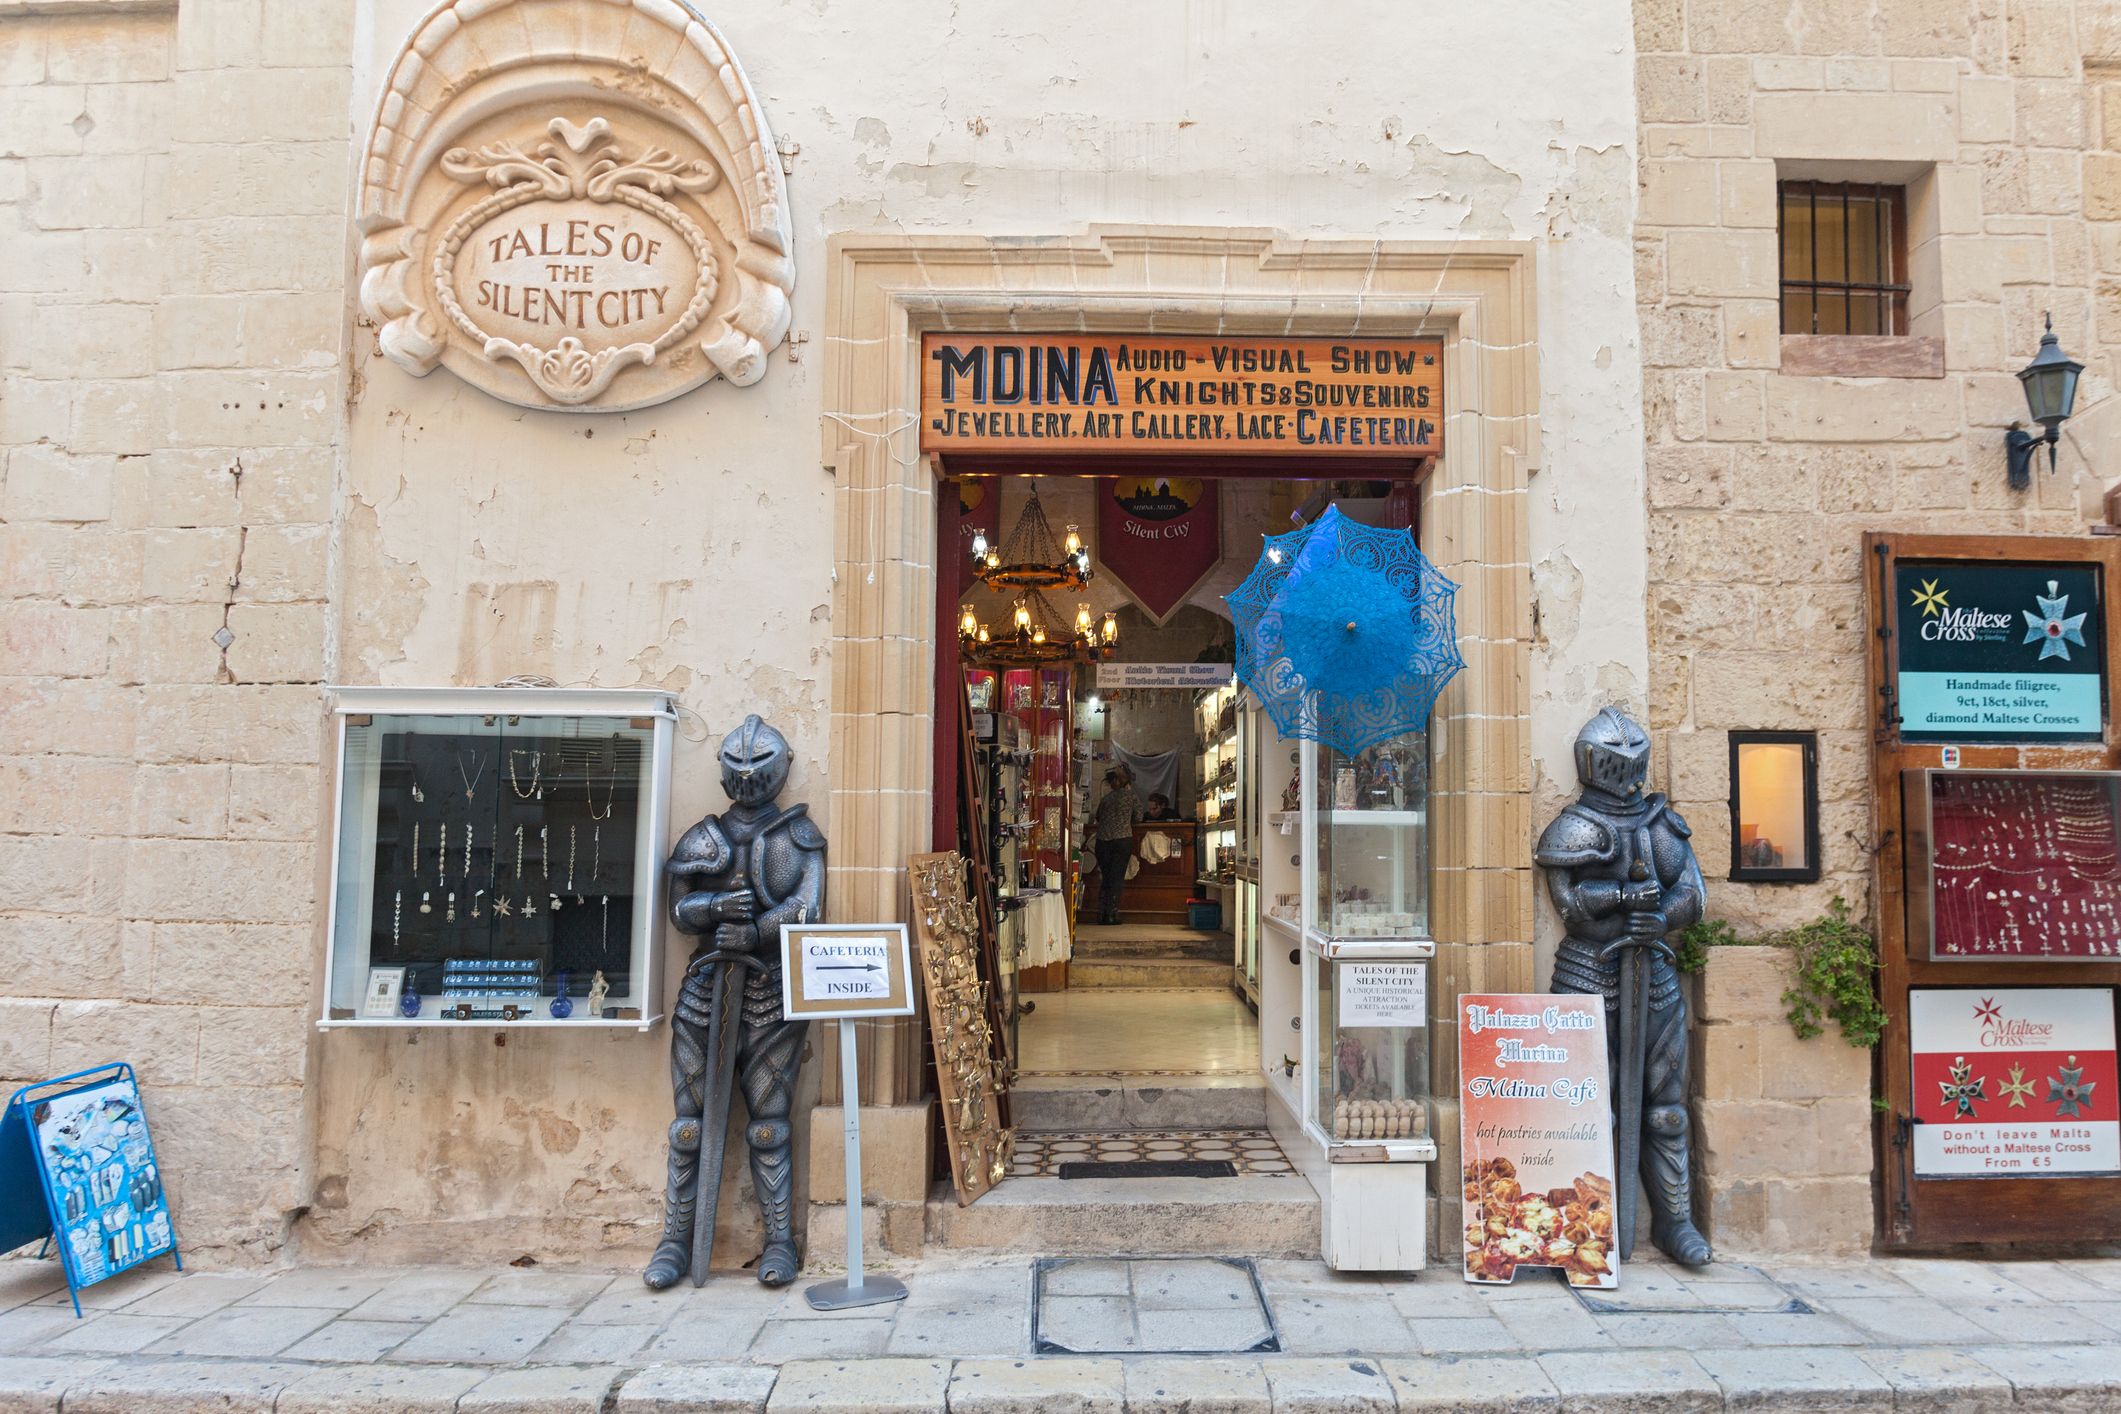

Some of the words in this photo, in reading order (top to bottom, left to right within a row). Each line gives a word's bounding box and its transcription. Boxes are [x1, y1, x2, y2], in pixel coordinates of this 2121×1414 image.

[488, 220, 616, 263] TALES
[621, 232, 662, 266] OF
[545, 264, 594, 283] THE
[477, 280, 593, 330] SILENT
[597, 285, 671, 329] CITY
[1116, 344, 1187, 372] AUDIO
[1210, 346, 1311, 373] VISUAL
[1331, 346, 1416, 375] SHOW
[940, 345, 1119, 406] MDINA
[940, 409, 1078, 438] JEWELLERY,
[1083, 411, 1124, 438] ART
[1132, 411, 1231, 440] GALLERY,
[1296, 409, 1429, 445] CAFETERIA
[1123, 520, 1160, 539] Silent
[1164, 521, 1190, 539] City
[1939, 607, 2012, 628] Maltese
[1920, 620, 1977, 641] Cross
[1946, 679, 2012, 690] Handmade
[2014, 679, 2061, 692] filigree,
[1956, 695, 1980, 708] 9ct,
[1982, 696, 2011, 708] 18ct,
[2012, 696, 2048, 708] silver,
[1925, 712, 1979, 724] diamond
[1982, 713, 2030, 724] Maltese
[2033, 713, 2080, 725] Crosses
[810, 945, 886, 957] CAFETERIA
[1353, 966, 1382, 974] TALES
[1384, 967, 1398, 975] OF
[1400, 967, 1419, 975] THE
[828, 983, 873, 993] INSIDE
[1356, 977, 1388, 985] SILENT
[1391, 977, 1415, 986] CITY
[1353, 987, 1381, 995] UNIQUE
[1467, 1004, 1539, 1033] Palazzo
[1543, 1006, 1595, 1033] Gatto
[1996, 1018, 2053, 1035] Maltese
[1980, 1030, 2025, 1047] Cross
[1496, 1038, 1568, 1067] Murina
[1469, 1077, 1546, 1098] Mdina
[1552, 1077, 1598, 1105] Café
[1476, 1121, 1496, 1138] hot
[1497, 1125, 1541, 1146] pastries
[1544, 1122, 1599, 1140] available
[1943, 1130, 1985, 1141] Don't
[1997, 1129, 2038, 1139] leave
[2050, 1128, 2092, 1139] Malta
[1943, 1143, 1990, 1154] without
[1993, 1146, 2001, 1154] a
[2004, 1143, 2051, 1153] Maltese
[2055, 1142, 2092, 1152] Cross
[1521, 1149, 1554, 1166] inside
[1985, 1157, 2021, 1168] From
